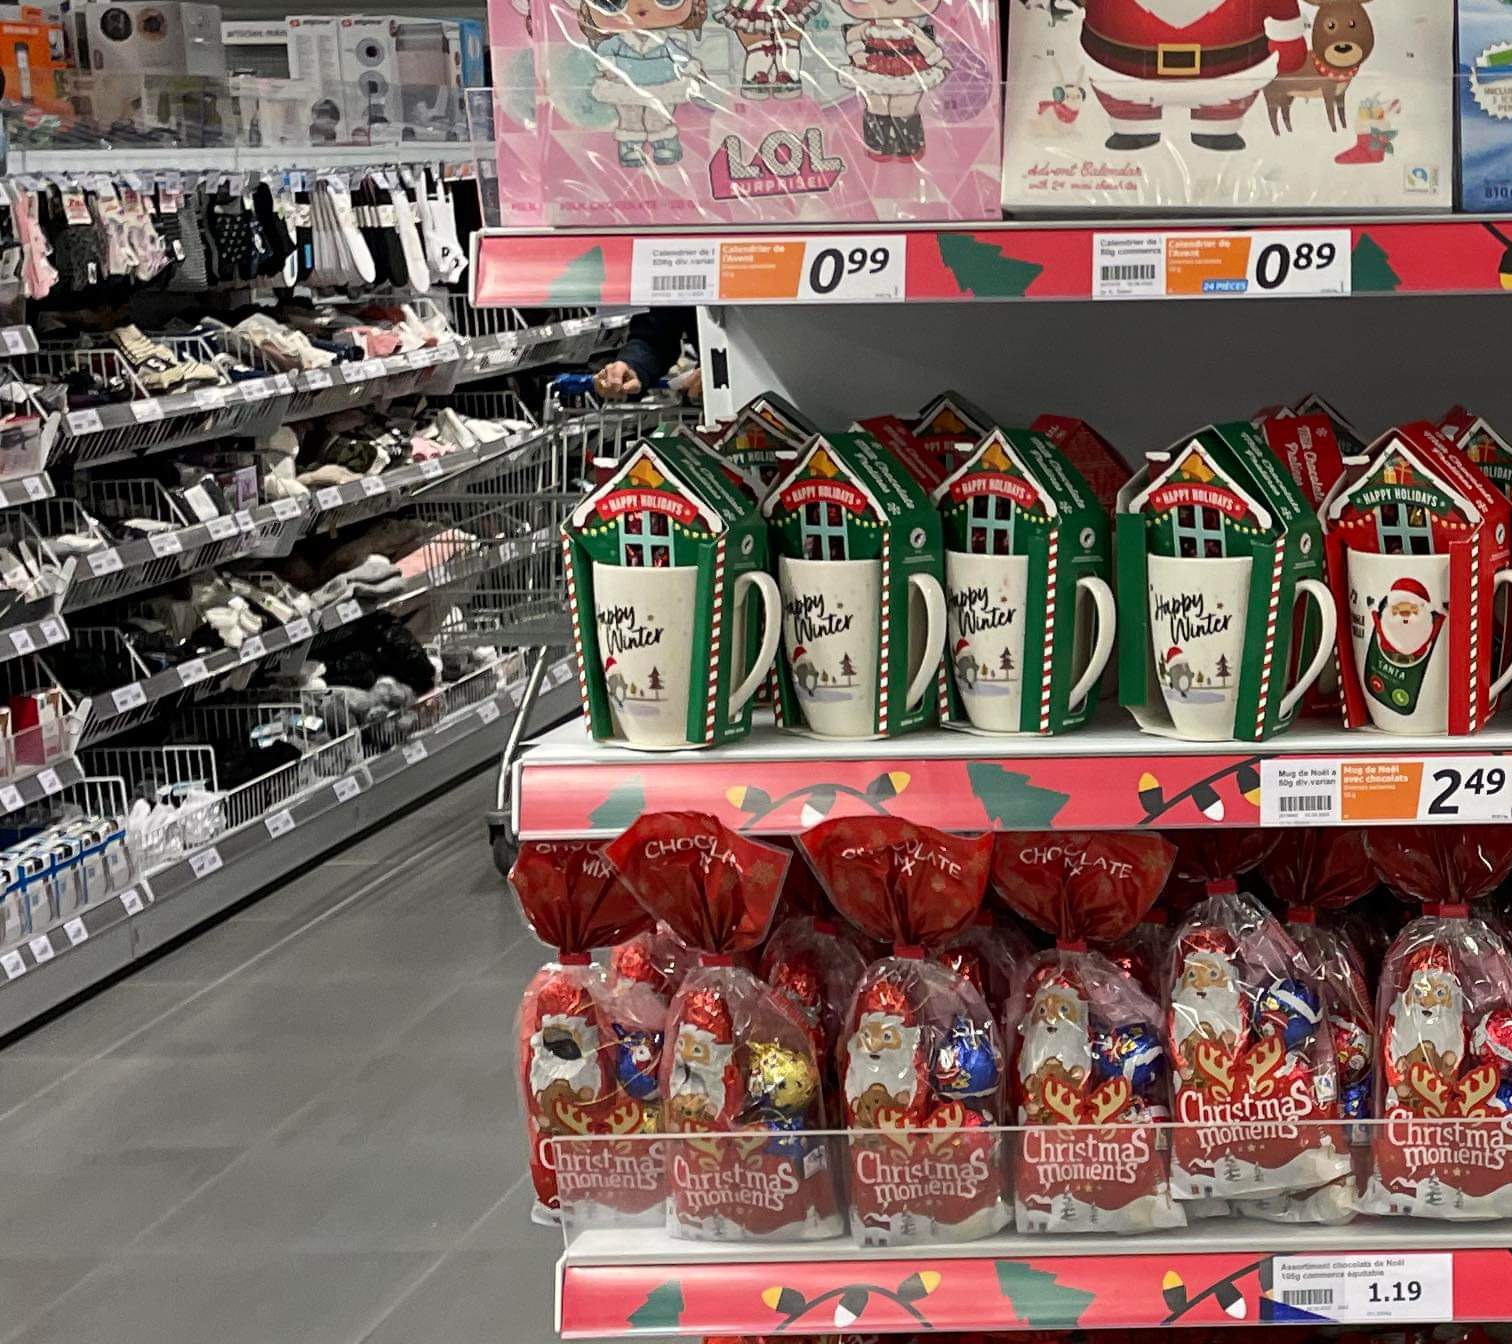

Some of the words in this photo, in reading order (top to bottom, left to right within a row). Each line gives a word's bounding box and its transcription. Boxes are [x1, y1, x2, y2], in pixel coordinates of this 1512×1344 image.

[791, 485, 817, 503] HAPPY
[817, 484, 855, 506] HOLIDAYS
[961, 477, 988, 494] HAPPY
[989, 477, 1026, 500] HOLIDAYS
[1161, 488, 1190, 505] HAPPY
[1191, 488, 1234, 511] HOLIDAYS
[1362, 487, 1393, 506] HAPPY
[1394, 486, 1439, 507] HOLIDAYS
[608, 493, 638, 512] HAPPY
[640, 493, 684, 517] HOLIDAYS
[957, 607, 1018, 638] Winter
[1154, 590, 1205, 625] Happy
[606, 626, 665, 656] Winter
[793, 613, 856, 643] Winter
[1169, 611, 1233, 645] Winter
[1278, 769, 1295, 779] Mug
[1298, 768, 1309, 778] de
[1343, 765, 1363, 775] Mug
[1365, 765, 1376, 774] de
[1343, 775, 1365, 784] avec
[1365, 774, 1409, 784] chocolats
[1019, 839, 1133, 879] CHOCLATE
[1179, 1079, 1315, 1128] Christmas
[1022, 1127, 1150, 1169] Christmas
[1197, 1115, 1299, 1152] moments
[855, 1147, 990, 1193] Christmas
[1404, 1142, 1508, 1173] moments
[673, 1150, 799, 1201] Christmas
[1036, 1158, 1138, 1192] moments
[685, 1182, 785, 1214] moments
[874, 1174, 977, 1210] moments
[1374, 1260, 1384, 1268] de
[1368, 1280, 1422, 1303] 1.19
